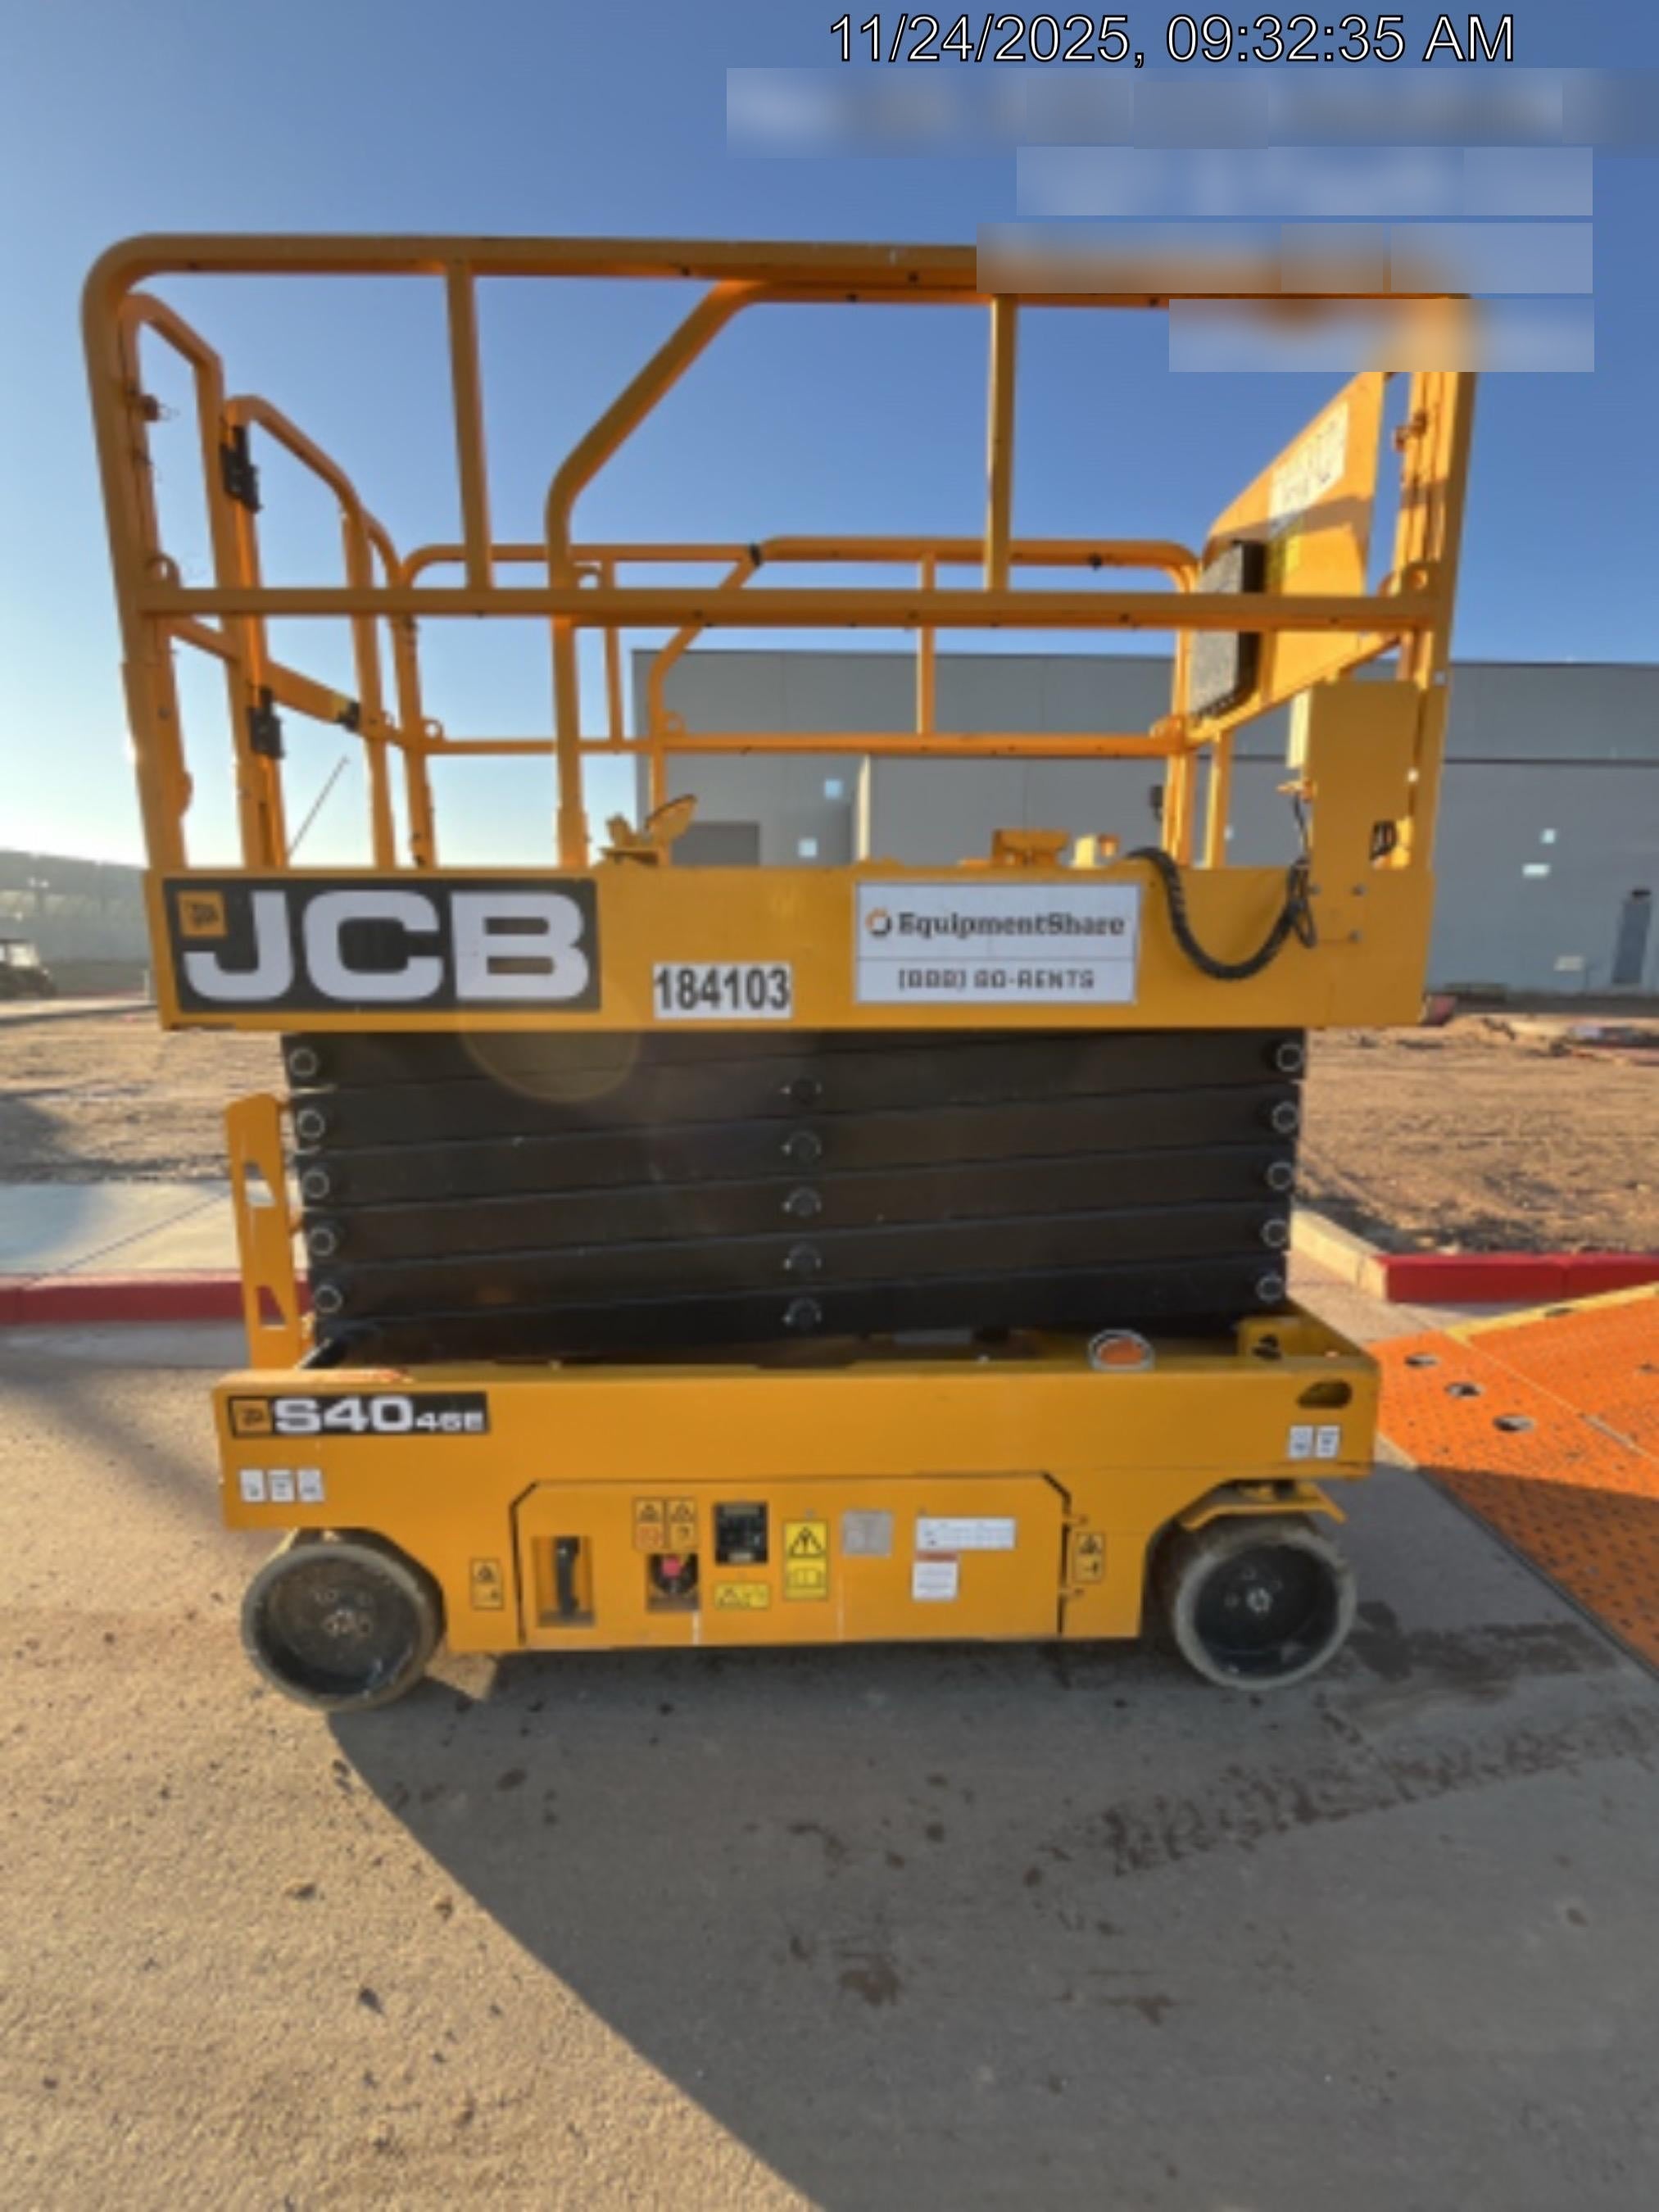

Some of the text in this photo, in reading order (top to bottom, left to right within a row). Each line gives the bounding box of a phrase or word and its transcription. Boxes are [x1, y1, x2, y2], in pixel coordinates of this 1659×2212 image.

[182, 890, 590, 1001] JCB
[898, 912, 1126, 939] EquipmentShare
[655, 967, 790, 1010] 184103
